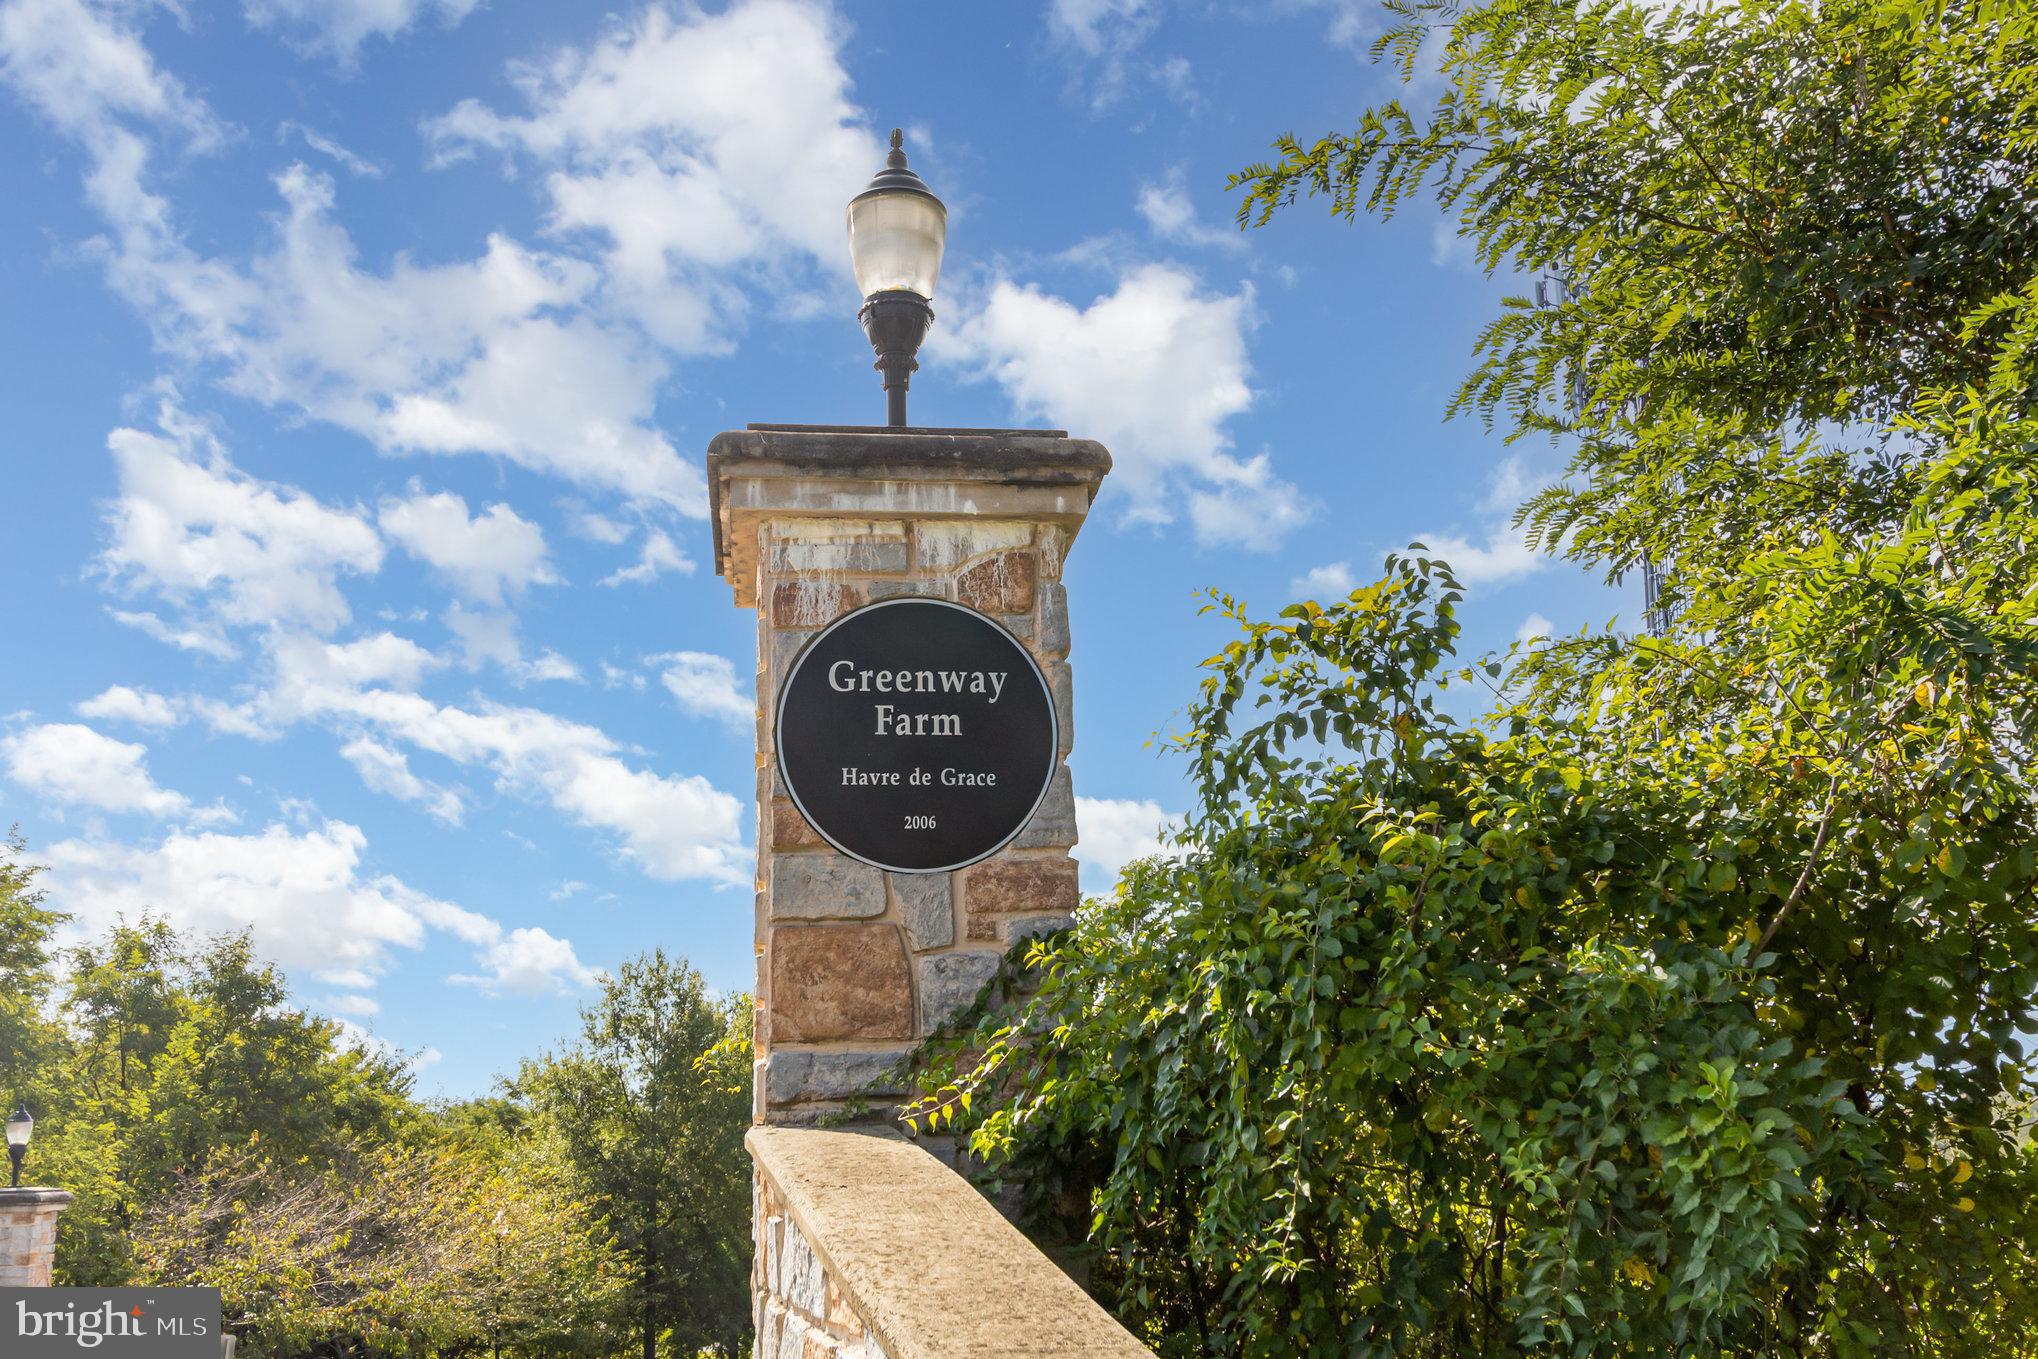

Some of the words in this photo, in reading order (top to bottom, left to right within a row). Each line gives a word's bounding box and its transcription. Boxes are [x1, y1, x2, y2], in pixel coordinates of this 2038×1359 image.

[828, 660, 1008, 704] Greenway
[874, 704, 963, 736] Farm
[841, 767, 901, 786] Havre
[909, 767, 932, 786] de
[940, 767, 996, 786] Grace
[904, 815, 937, 830] 2006
